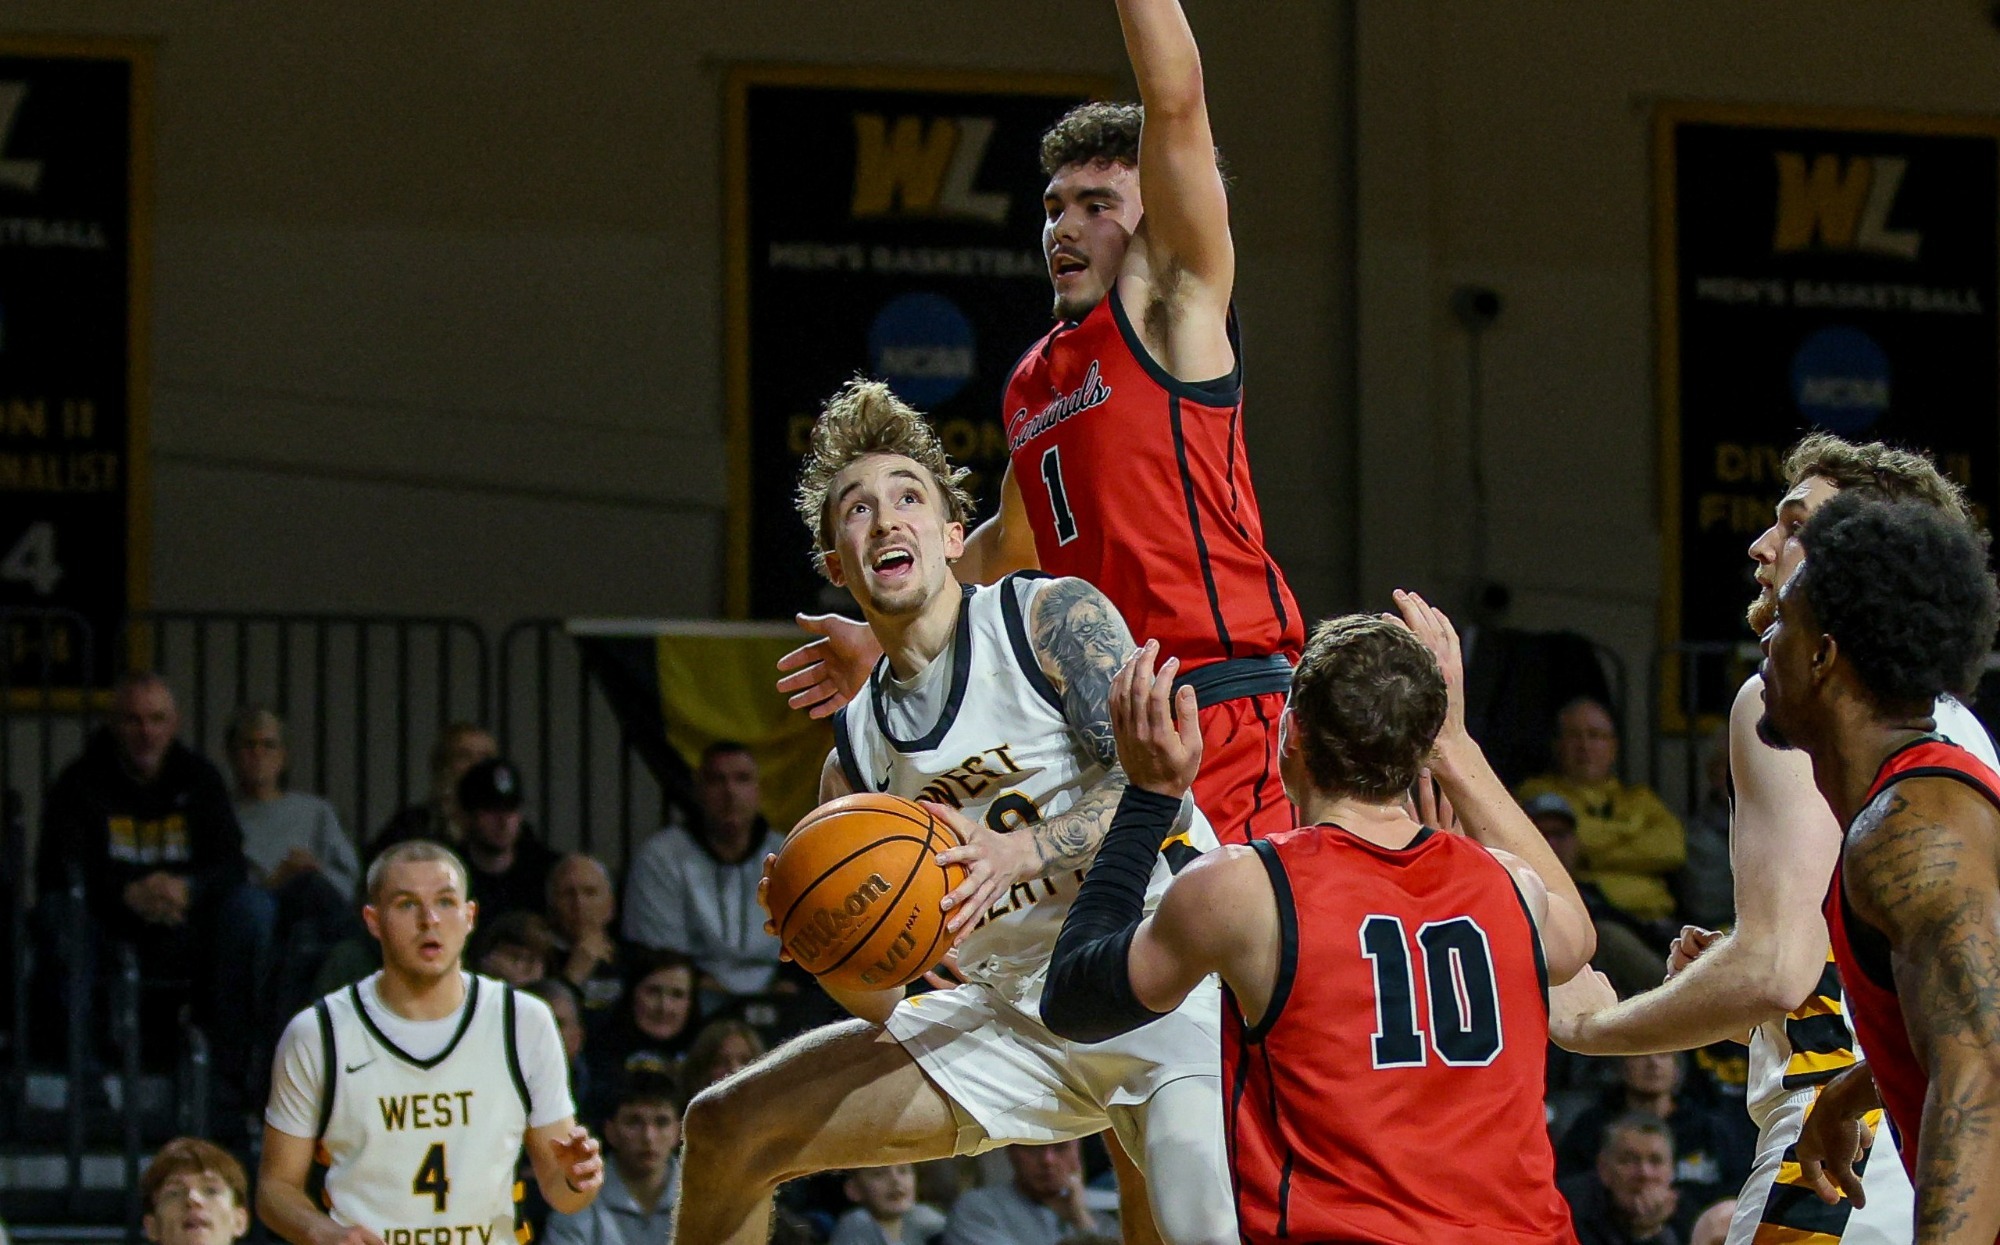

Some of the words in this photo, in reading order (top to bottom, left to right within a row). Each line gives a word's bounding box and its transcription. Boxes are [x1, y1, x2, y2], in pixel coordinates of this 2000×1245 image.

[850, 110, 1012, 224] WL
[1769, 149, 1924, 262] WL
[1792, 278, 1983, 314] BASKETBALL
[1040, 443, 1080, 547] 1
[914, 743, 1020, 811] WEST
[788, 872, 893, 963] Wilson
[905, 903, 922, 932] NXT
[1358, 914, 1504, 1071] 10
[378, 1090, 474, 1131] WEST
[412, 1141, 449, 1213] 4
